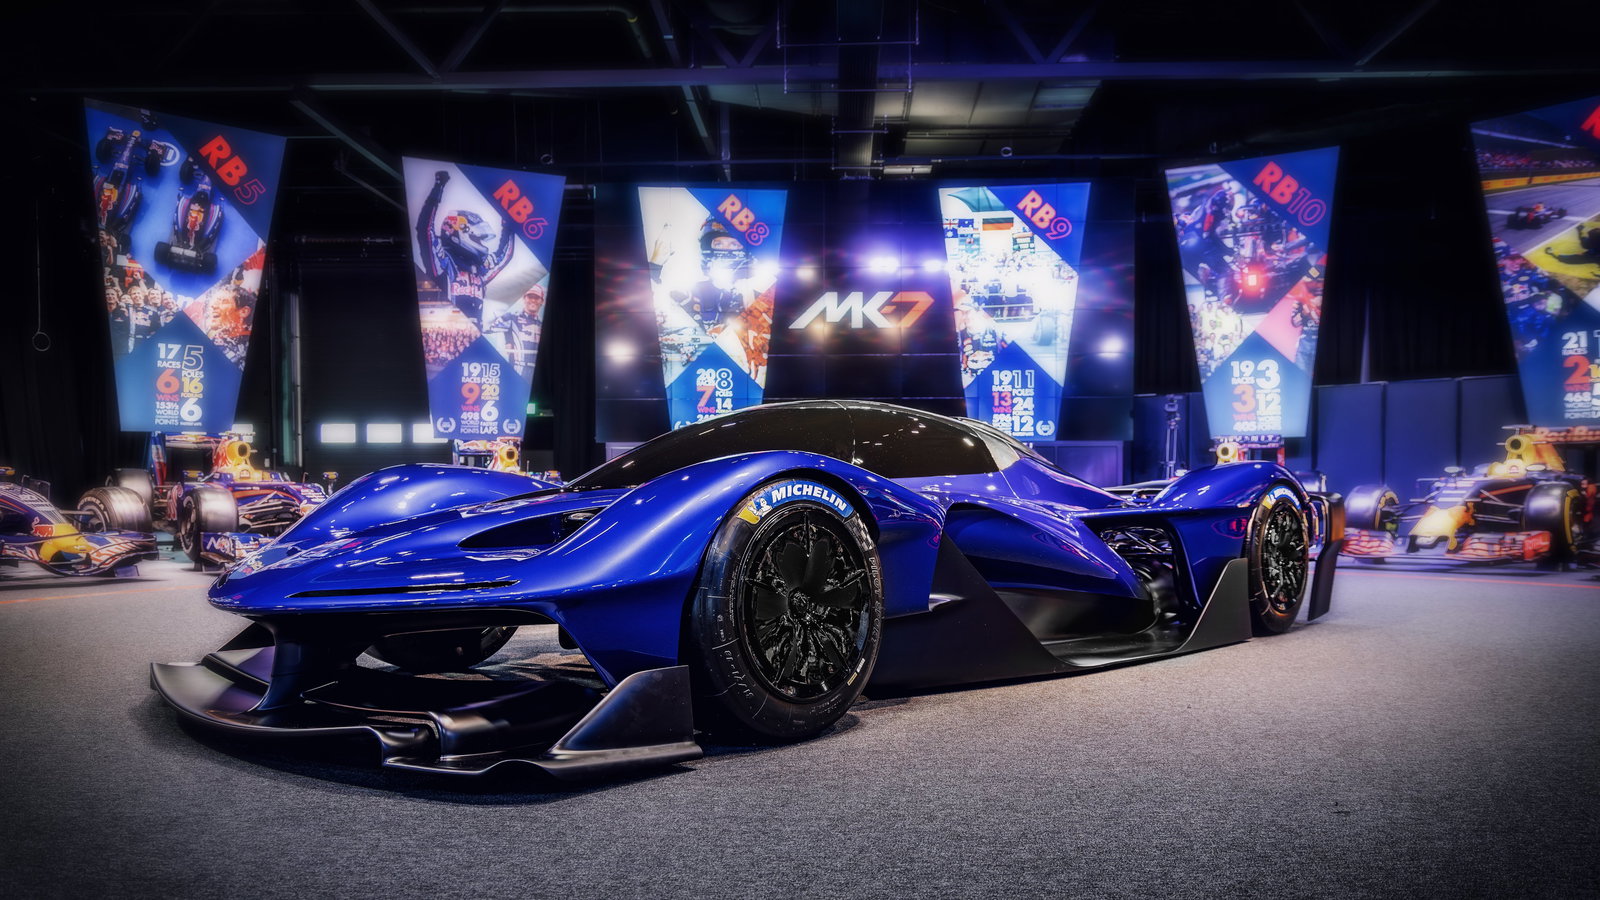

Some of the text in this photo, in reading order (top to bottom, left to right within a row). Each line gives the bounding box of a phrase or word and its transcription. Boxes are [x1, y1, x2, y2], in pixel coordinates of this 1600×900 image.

[199, 135, 266, 205] RB5
[1253, 161, 1327, 227] RB10
[493, 179, 549, 240] RB6
[717, 194, 769, 246] RB8
[1017, 190, 1072, 240] RB9
[1561, 331, 1588, 349] 21
[158, 343, 181, 359] 17
[182, 345, 204, 371] 5
[182, 370, 204, 378] POLES
[462, 362, 481, 376] 19
[481, 363, 500, 377] 15
[716, 368, 733, 390] 8
[992, 370, 1012, 385] 19
[1231, 360, 1255, 377] 19
[1256, 359, 1280, 389] 3
[1563, 355, 1591, 385] 2
[156, 368, 180, 394] 6
[182, 378, 204, 393] 16
[481, 384, 500, 396] 20
[461, 383, 480, 404] 9
[696, 386, 715, 407] 7
[716, 398, 733, 410] 14
[992, 391, 1012, 406] 13
[1012, 397, 1034, 411] 24
[1232, 384, 1256, 413] 3
[1256, 393, 1281, 411] 12
[180, 398, 202, 422] 6
[481, 400, 499, 421] 6
[1012, 416, 1034, 431] 12
[771, 484, 847, 511] MICHELIN
